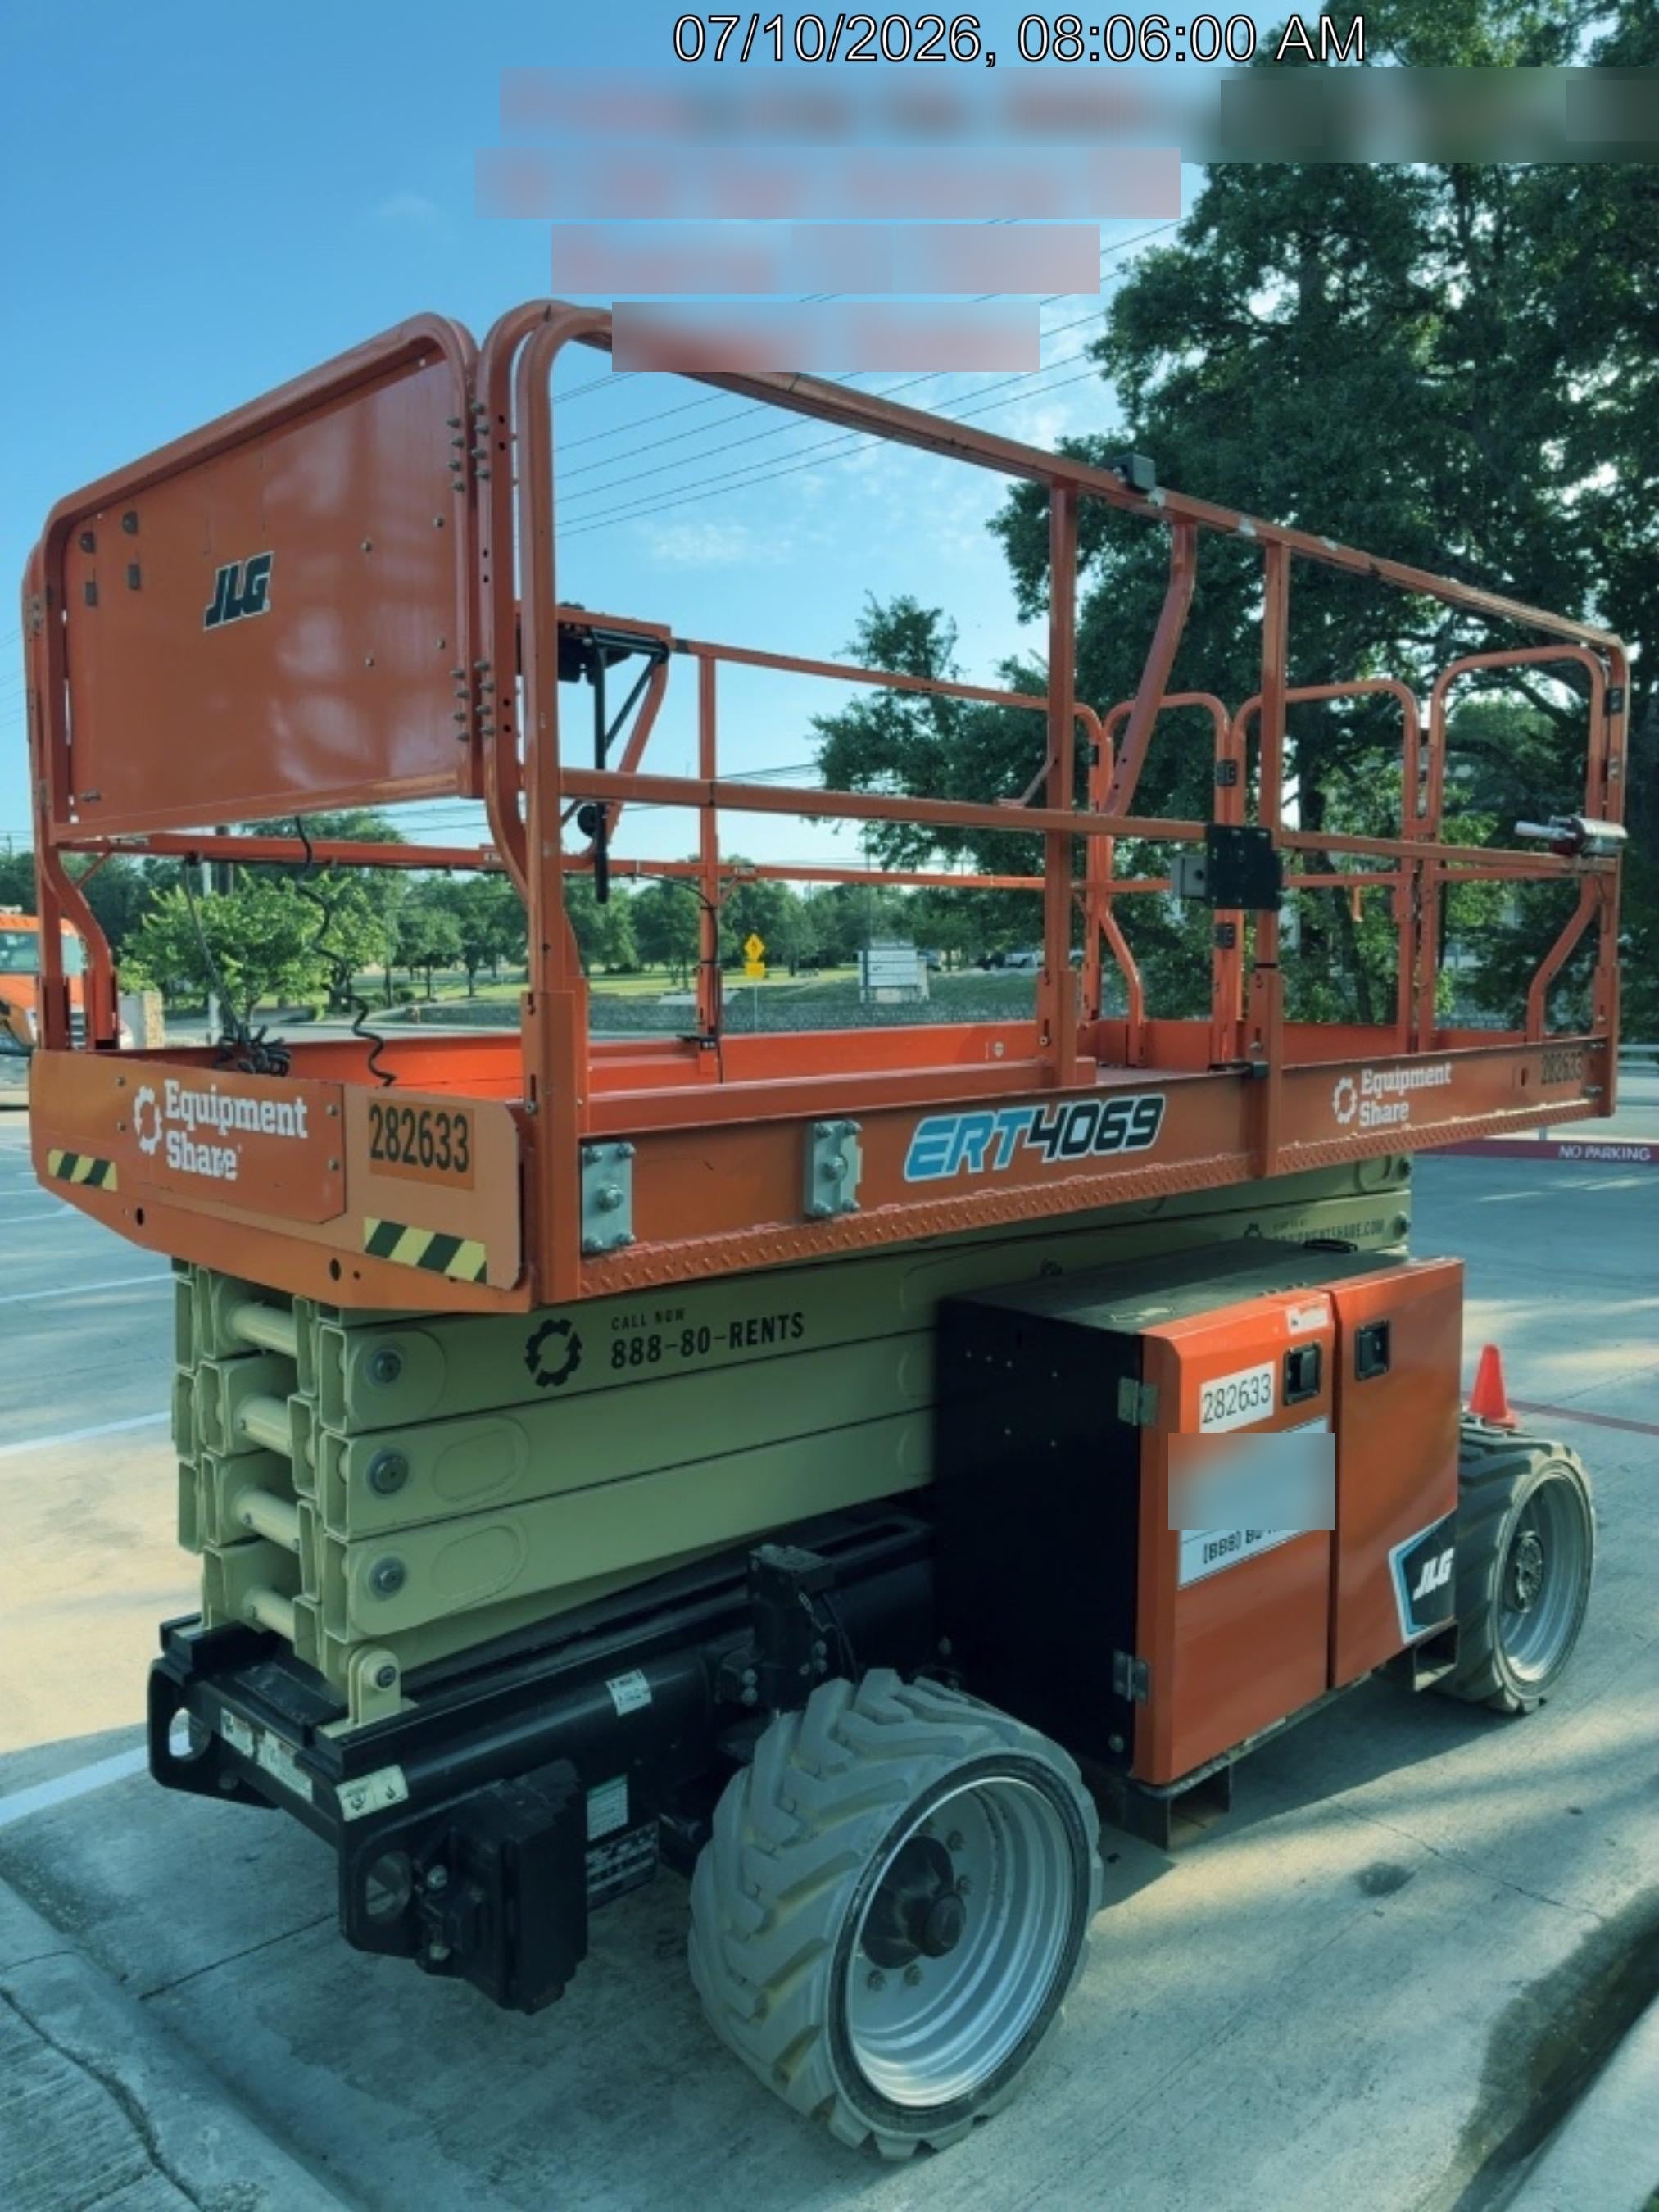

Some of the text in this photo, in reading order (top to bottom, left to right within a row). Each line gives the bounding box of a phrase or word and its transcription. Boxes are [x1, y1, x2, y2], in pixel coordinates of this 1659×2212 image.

[203, 550, 274, 631] JLG
[1361, 1062, 1452, 1095] Equipment
[165, 1078, 308, 1138] Equipment
[1359, 1099, 1409, 1127] Share
[165, 1130, 238, 1180] Share
[369, 1104, 470, 1173] 282633
[1558, 1145, 1651, 1162] NO PARKING
[610, 1312, 805, 1370] 888-80-RENTS
[611, 1314, 647, 1331] CALL
[1202, 1372, 1271, 1425] 282633
[1413, 1548, 1454, 1601] JLG
